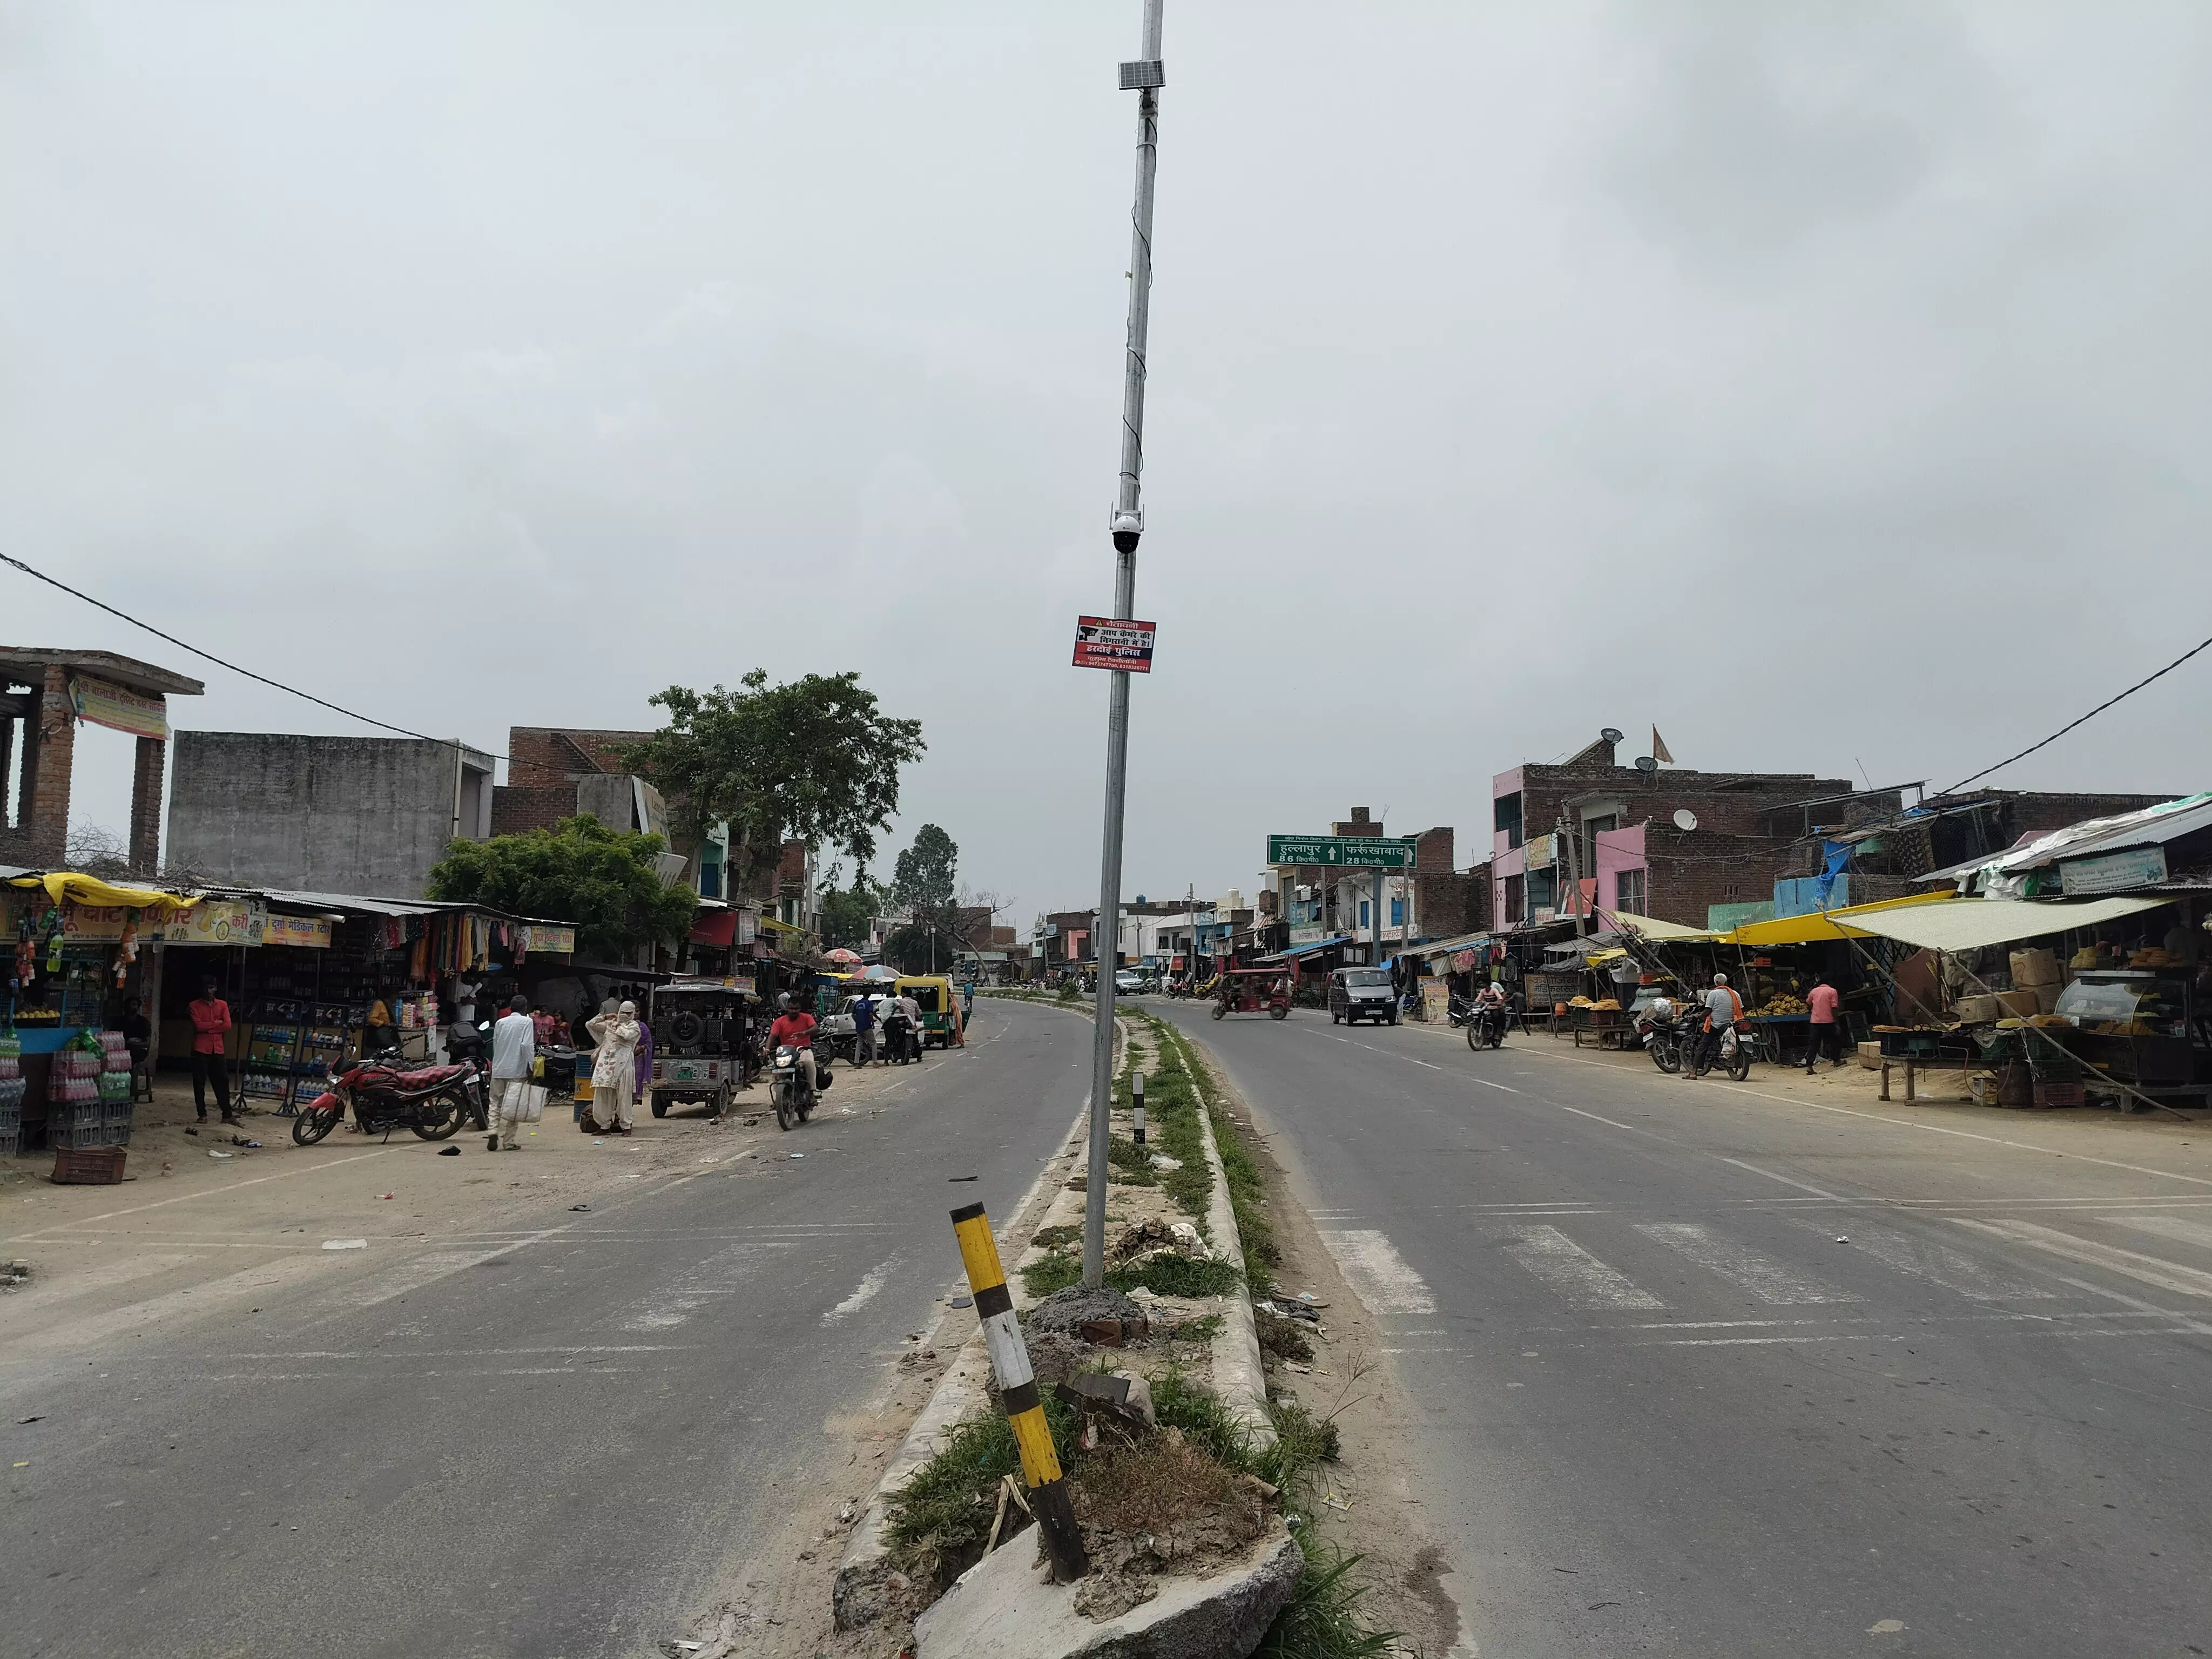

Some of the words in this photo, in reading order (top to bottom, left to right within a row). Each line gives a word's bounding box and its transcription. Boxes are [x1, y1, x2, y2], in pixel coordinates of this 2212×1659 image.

[1106, 621, 1139, 629] चेतावनी
[1100, 636, 1129, 645] निगरानी
[1086, 644, 1112, 654] हरदोई
[1115, 648, 1142, 657] पुलिस
[80, 681, 89, 693] श्री
[91, 685, 117, 702] बालाजी
[1279, 844, 1321, 855] हुल्लापुर
[271, 918, 286, 932] दुर्गा
[287, 919, 314, 932] मेडिकल
[316, 922, 330, 934] स्टोर
